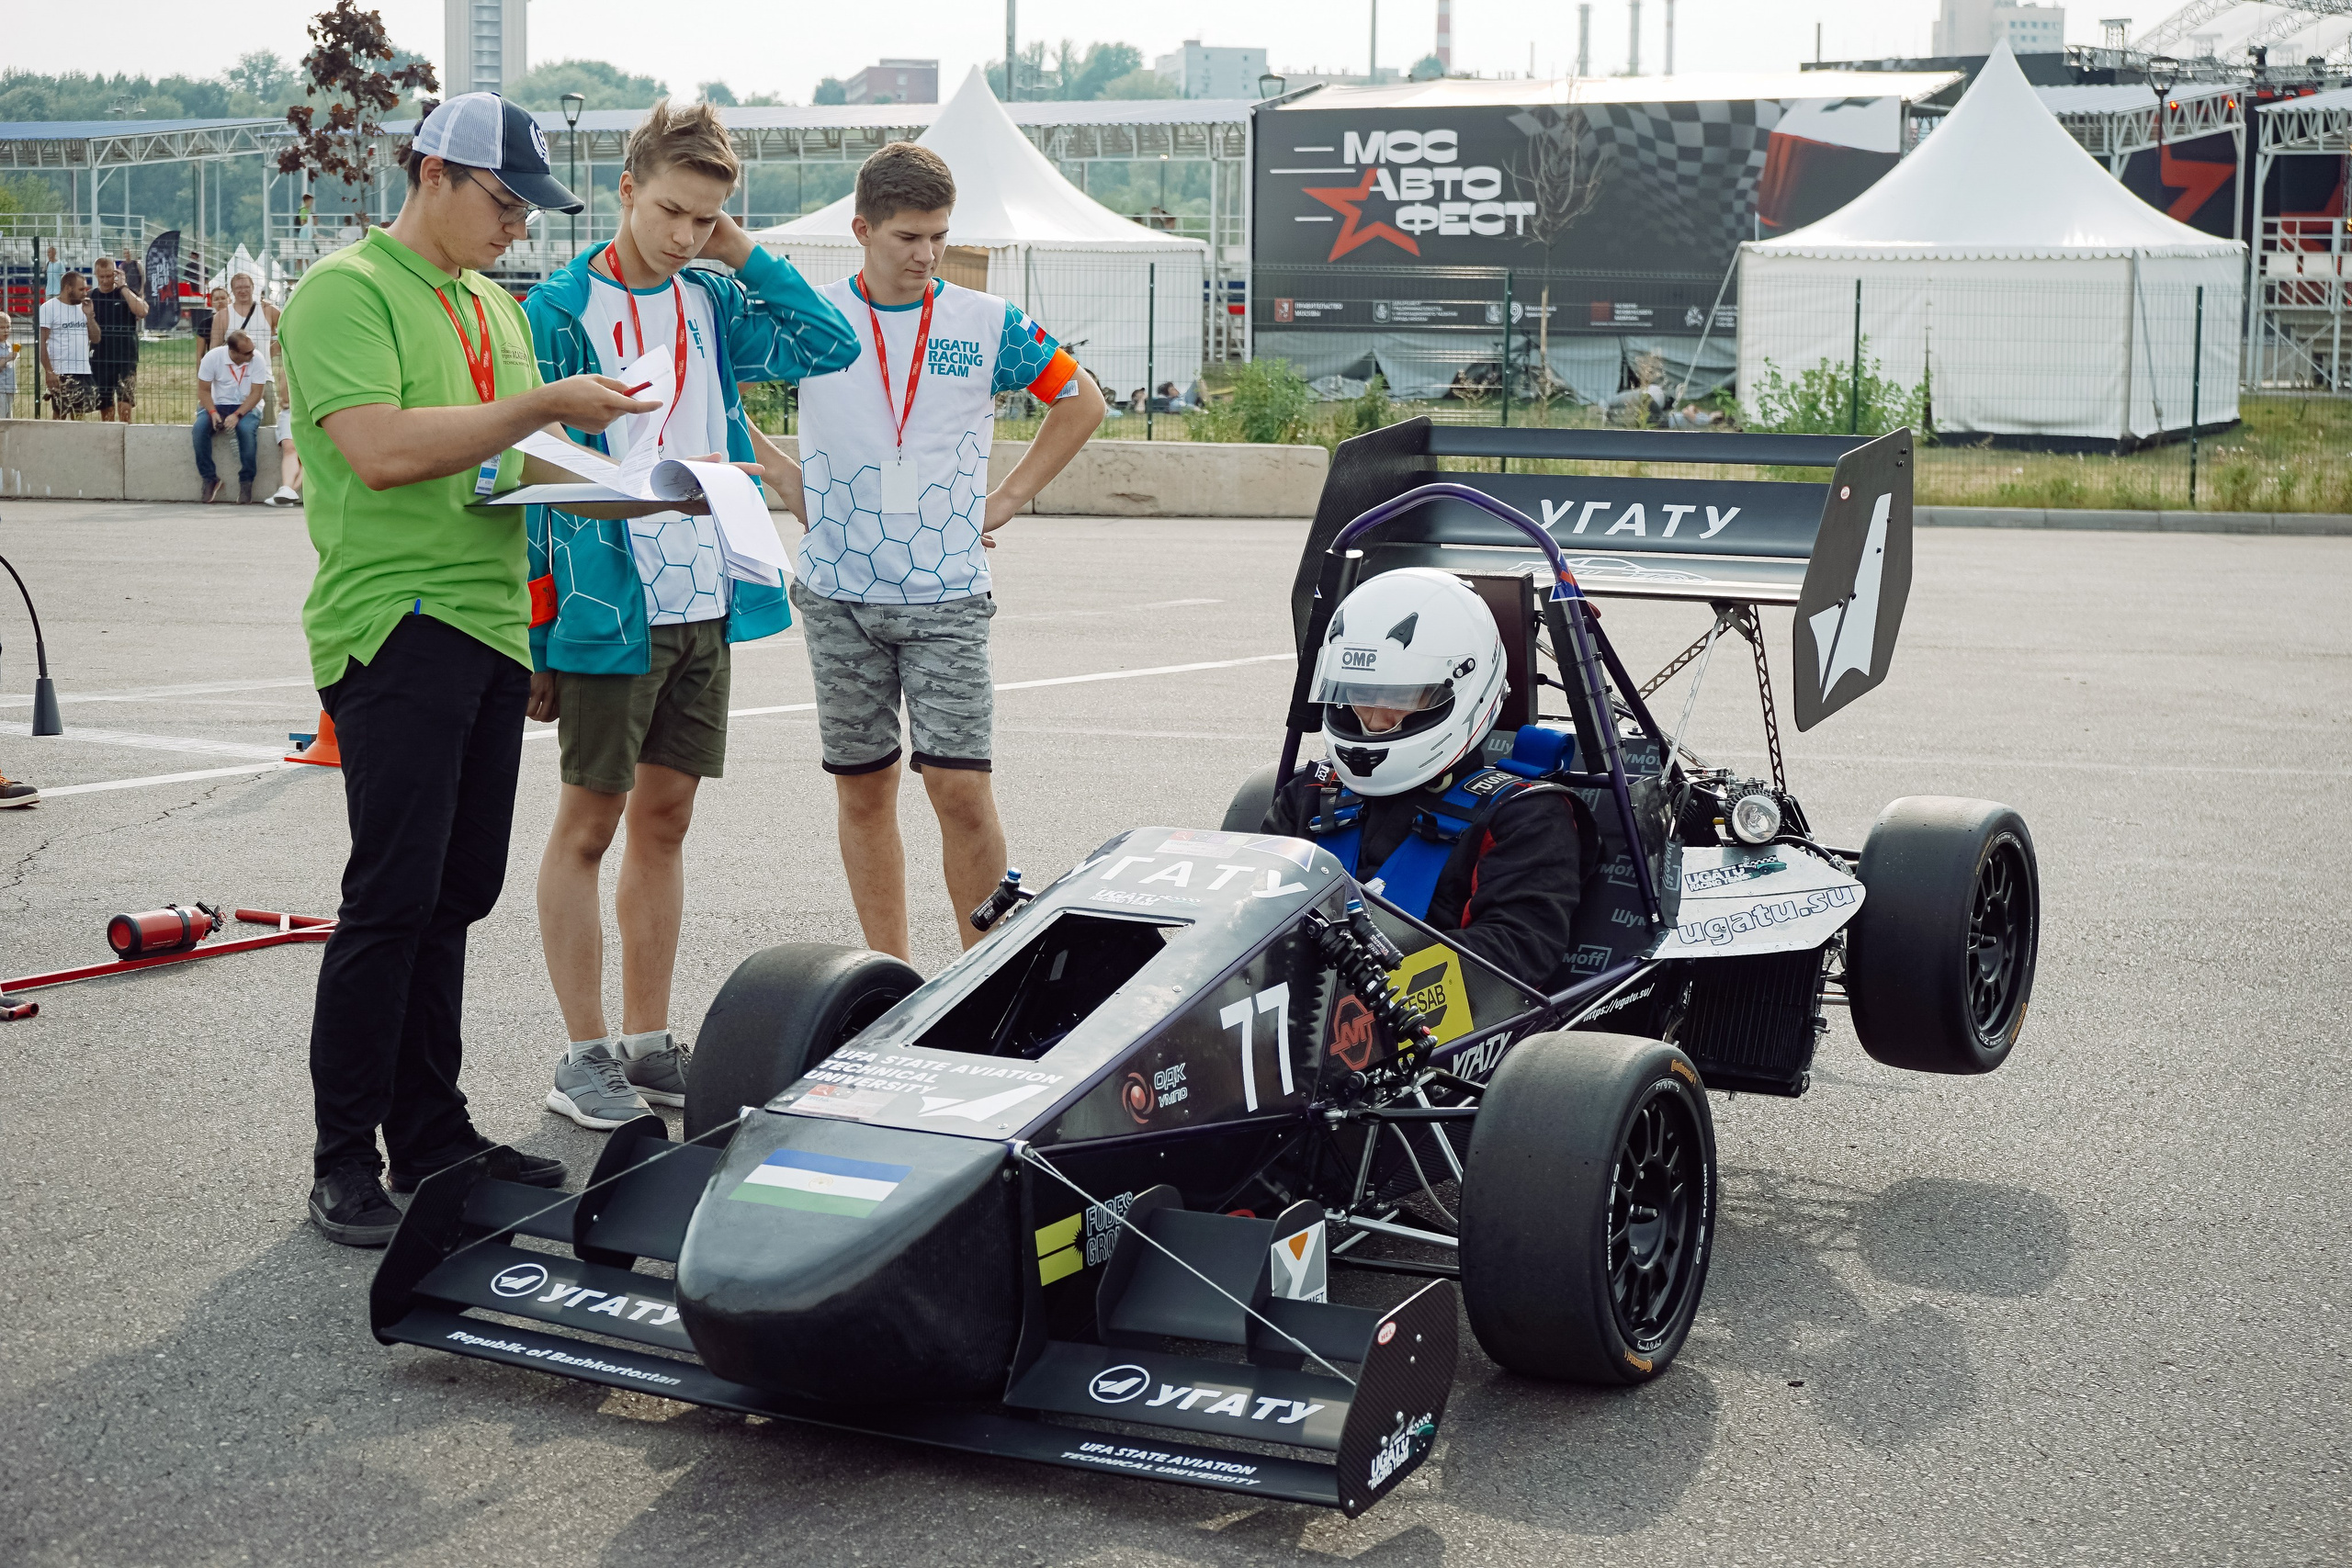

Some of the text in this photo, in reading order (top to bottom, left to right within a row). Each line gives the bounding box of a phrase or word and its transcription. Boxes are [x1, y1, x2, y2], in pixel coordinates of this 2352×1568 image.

[1343, 129, 1458, 164] МОС
[1366, 165, 1502, 201] АВТО
[1395, 200, 1537, 236] ФЕСТ
[928, 338, 979, 355] UGATU
[928, 350, 983, 367] RACING
[928, 362, 969, 378] TEAM
[1540, 499, 1742, 540] УГАТУ
[1342, 651, 1377, 668] OMP
[1057, 854, 1309, 898] УГАТУ
[1685, 863, 1746, 886] UGATU
[1690, 877, 1724, 893] RACING
[1094, 889, 1161, 904] UGATU
[1677, 886, 1856, 946] ugatu.su
[1408, 984, 1446, 1013] ESAB
[1220, 981, 1295, 1113] 77
[1452, 1031, 1513, 1080] УГАТУ
[803, 1070, 939, 1095] UNIVERSITY
[819, 1059, 940, 1084] TECHNICAL
[833, 1049, 1064, 1085] UFA STATE AVIATION
[1154, 1062, 1187, 1091] ОДК
[1158, 1087, 1188, 1109] УМПО
[1086, 1225, 1121, 1267] GRO
[537, 1282, 681, 1325] УГАТУ
[447, 1330, 682, 1387] Republic of Bashkortostan
[1145, 1383, 1326, 1425] УГАТУ
[1060, 1450, 1261, 1486] TECHNICAL UNIVERSITY
[1080, 1441, 1258, 1476] UFA STATE AVIATION
[1371, 1433, 1410, 1479] UGATU
